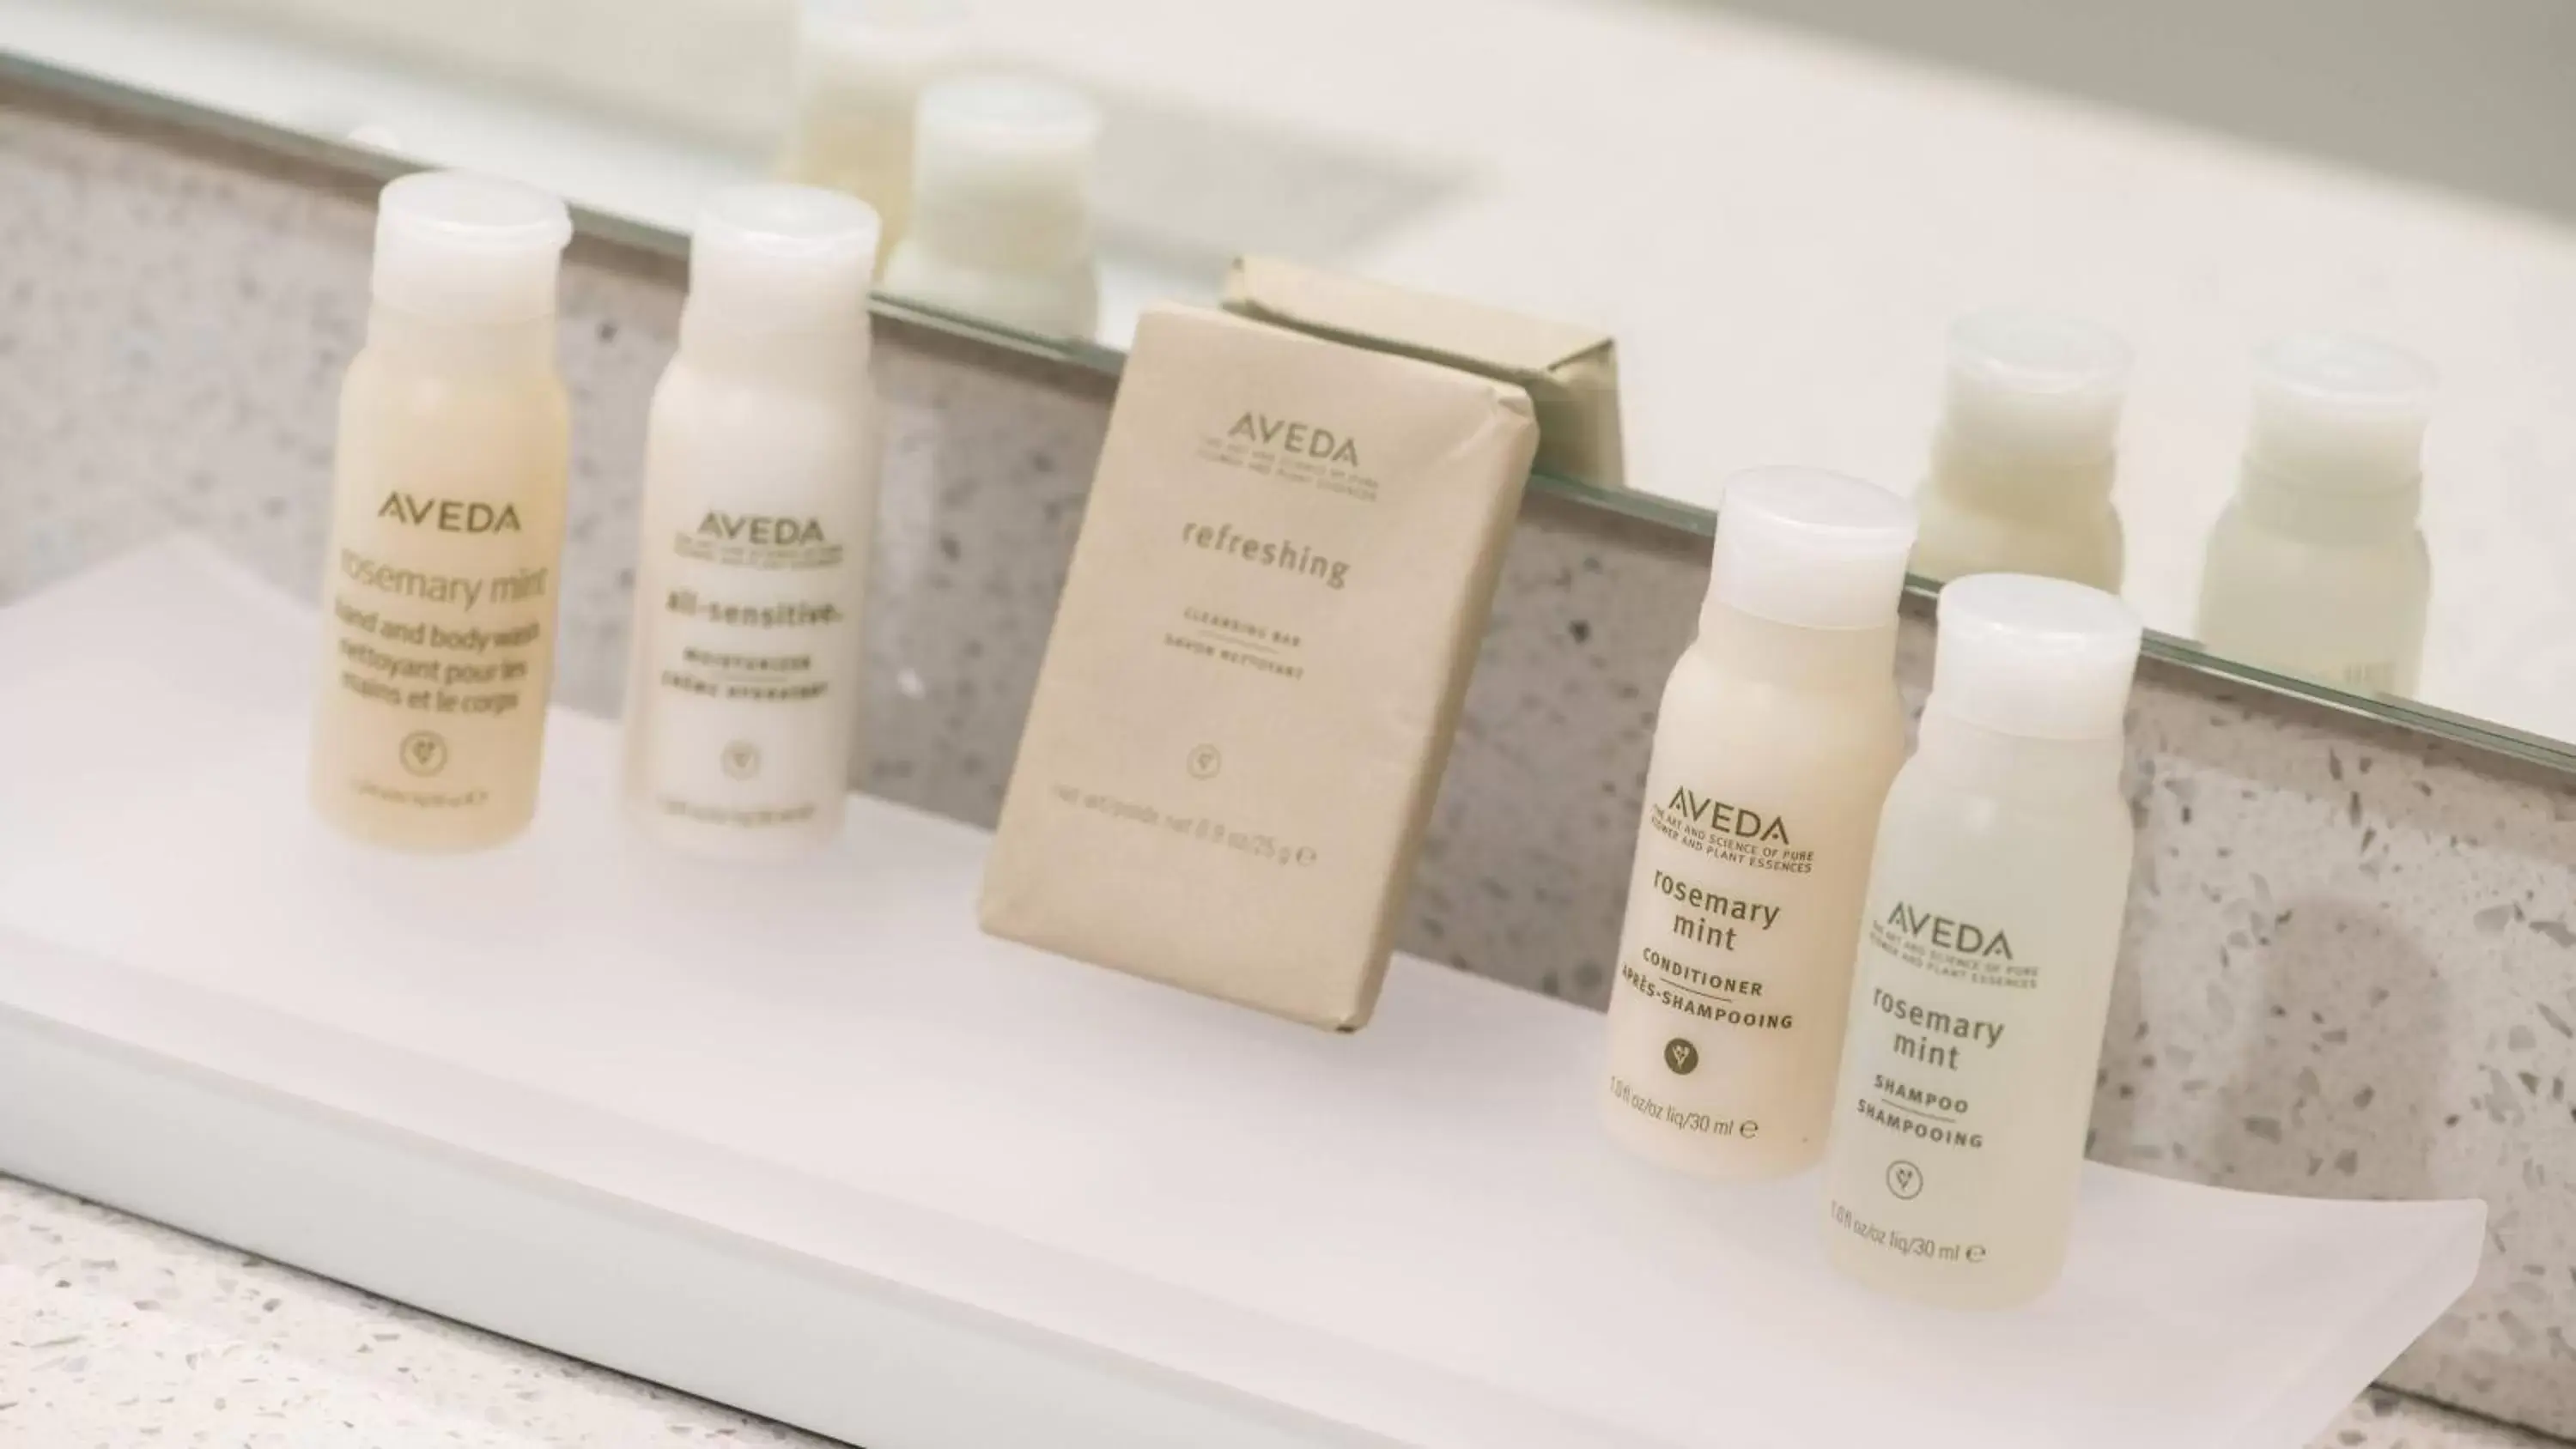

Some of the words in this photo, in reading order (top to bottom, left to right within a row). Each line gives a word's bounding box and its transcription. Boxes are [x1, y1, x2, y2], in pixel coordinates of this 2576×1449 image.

[1227, 410, 1359, 468] AVEDA
[378, 490, 522, 535] AVEDA
[697, 511, 825, 546] AVEDA
[1181, 521, 1351, 591] refreshing
[1668, 785, 1789, 846] AVEDA
[1680, 835, 1704, 852] AND
[1706, 845, 1746, 864] PLANT
[1684, 824, 1705, 840] AND
[1709, 834, 1758, 857] SCIENCE
[1762, 846, 1779, 858] OF
[1654, 869, 1781, 931] rosemary
[1673, 912, 1739, 952] mint
[1887, 900, 2014, 961] AVEDA
[1643, 947, 1764, 997] CONDITIONER
[1622, 963, 1794, 1030] APRÈS-SHAMPOOING
[1872, 986, 2005, 1049] rosemary
[1893, 1032, 1961, 1071] mint
[1874, 1073, 1970, 1114] SHAMPOO
[1713, 1119, 1735, 1136] ml
[1856, 1099, 1984, 1149] SHAMPOOING
[1939, 1245, 1960, 1262] ml
